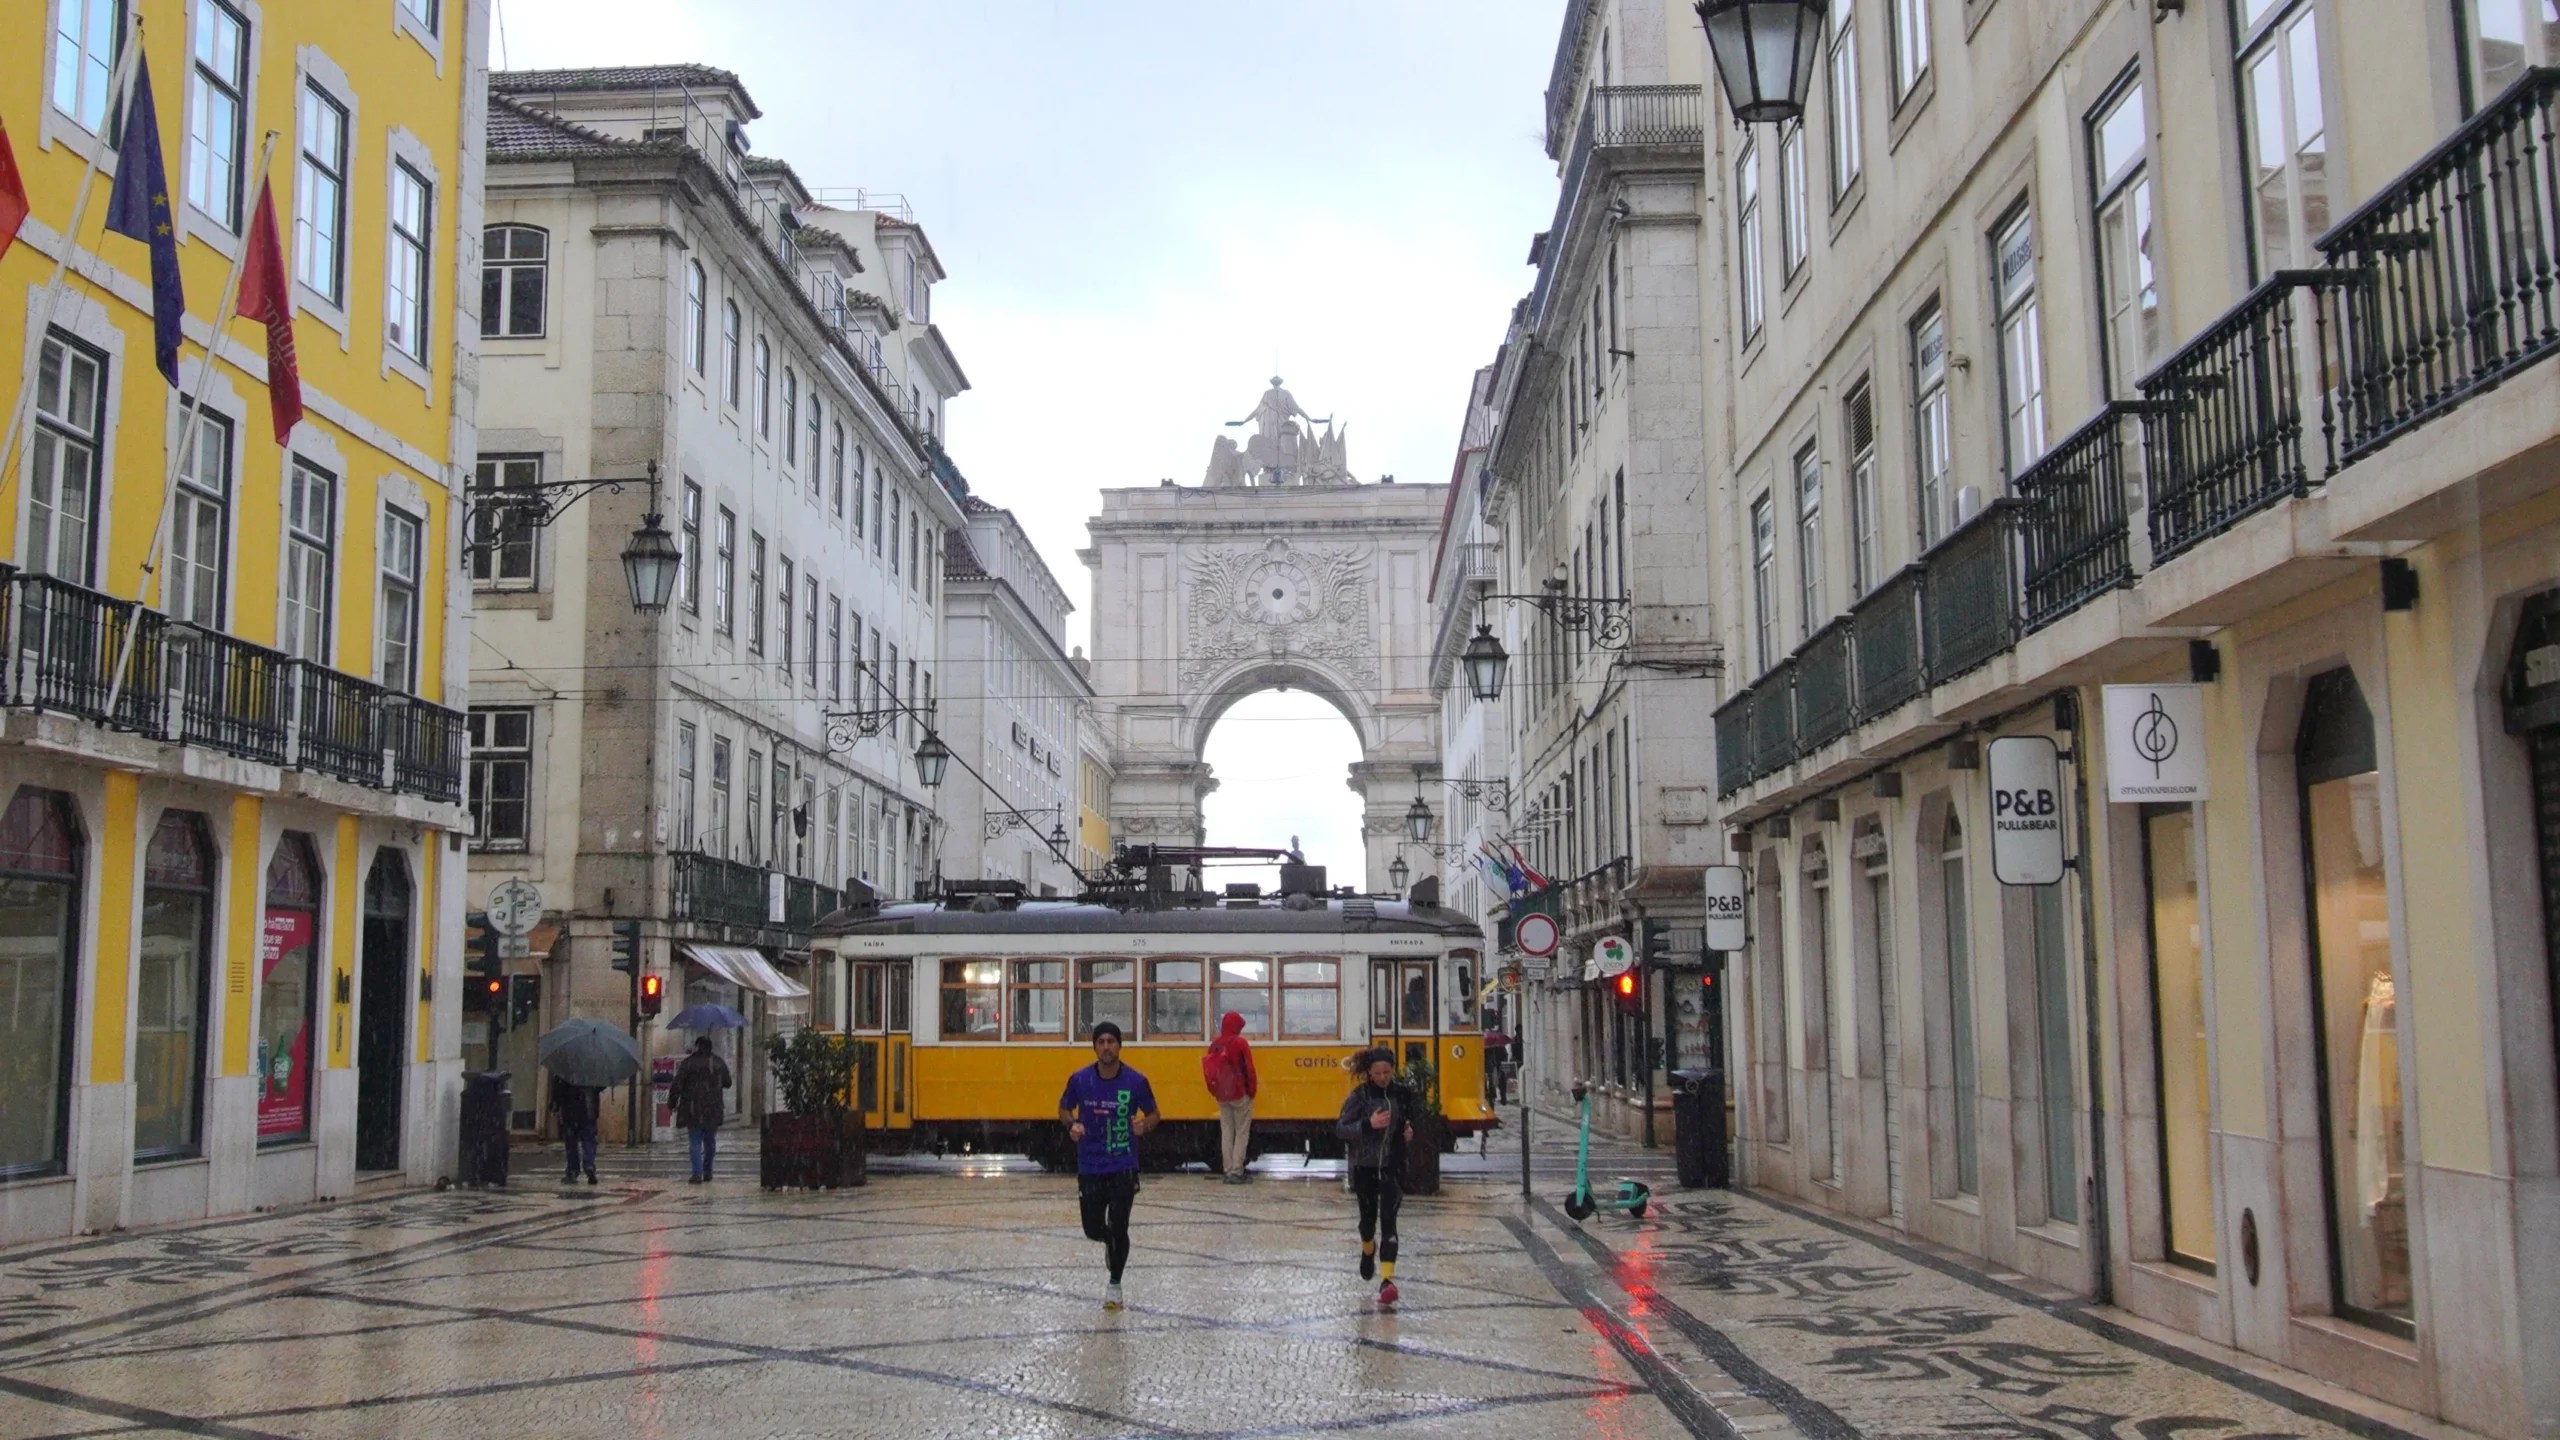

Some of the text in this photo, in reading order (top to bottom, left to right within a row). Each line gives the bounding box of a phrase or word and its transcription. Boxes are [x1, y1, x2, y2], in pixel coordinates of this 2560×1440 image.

[2121, 785, 2197, 795] STRADIVARIUS.COM
[1996, 788, 2055, 817] P&B
[1997, 820, 2058, 831] PULL&BEAR
[1708, 895, 1742, 912] P&B
[1132, 939, 1147, 947] 575
[1294, 1055, 1338, 1068] carris
